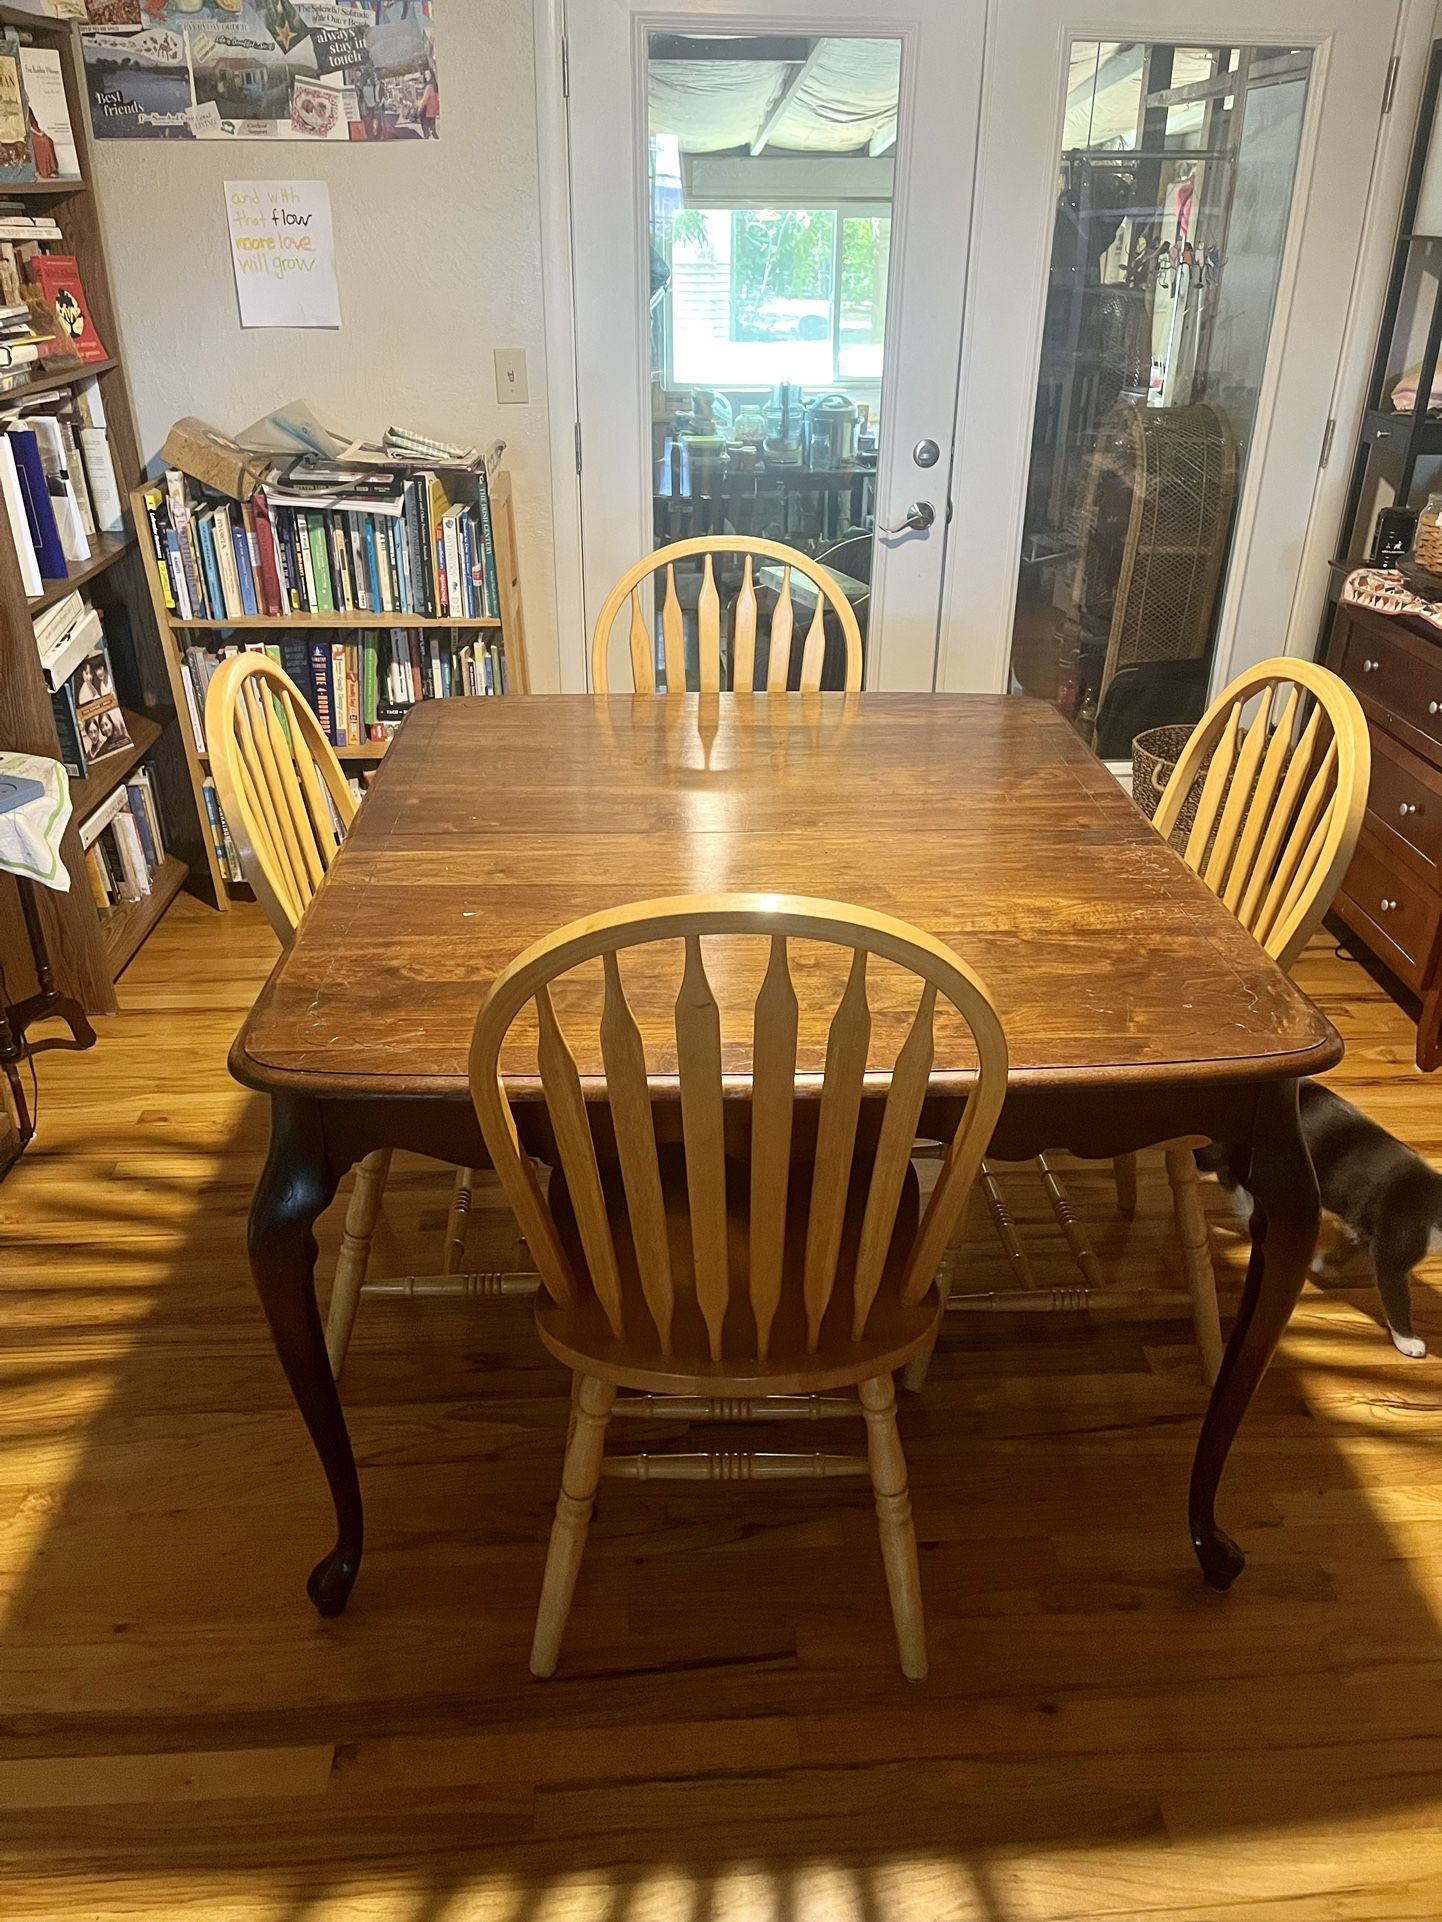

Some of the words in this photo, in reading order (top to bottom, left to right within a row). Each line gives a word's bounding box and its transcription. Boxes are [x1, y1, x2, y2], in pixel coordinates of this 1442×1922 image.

[316, 28, 356, 43] always
[329, 41, 352, 54] stay
[354, 37, 367, 49] in
[328, 50, 362, 67] touch
[95, 91, 122, 105] Best
[104, 101, 145, 117] friends
[231, 188, 260, 205] and
[268, 187, 300, 204] with
[233, 209, 266, 228] that
[272, 208, 312, 226] flow
[278, 232, 316, 252] love
[237, 253, 269, 274] will
[273, 257, 316, 280] grow
[483, 523, 492, 554] CENTURY
[315, 672, 327, 686] THE
[317, 687, 329, 714] 4-HOUR
